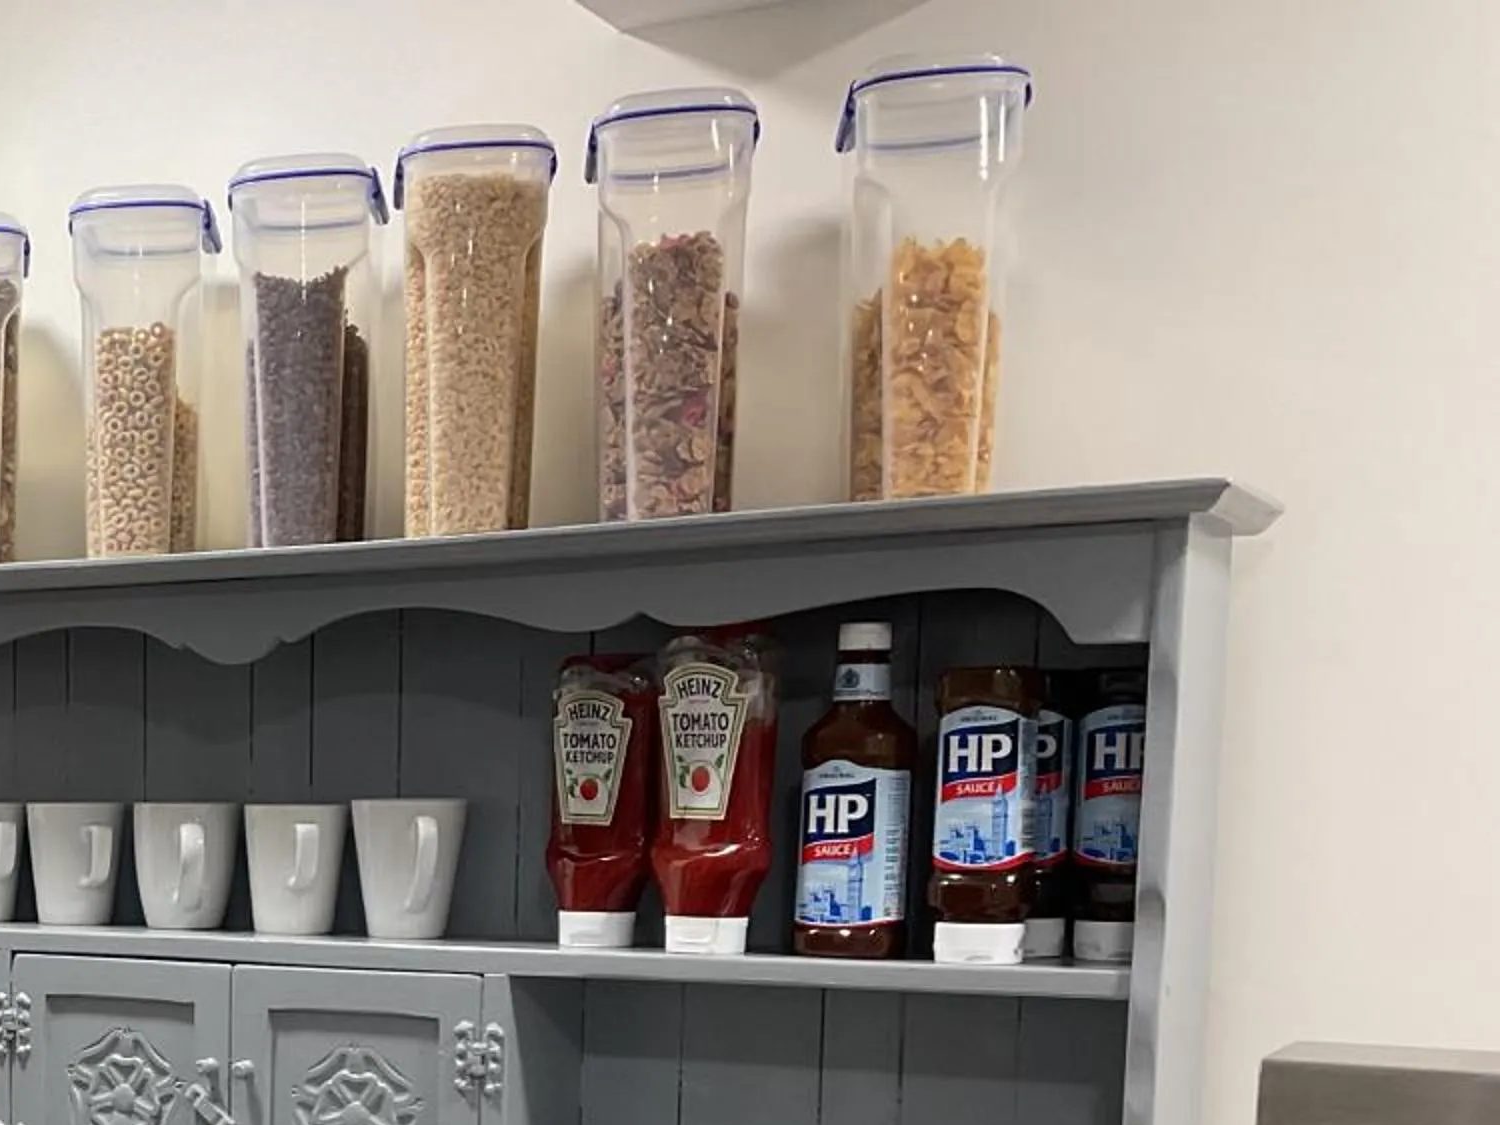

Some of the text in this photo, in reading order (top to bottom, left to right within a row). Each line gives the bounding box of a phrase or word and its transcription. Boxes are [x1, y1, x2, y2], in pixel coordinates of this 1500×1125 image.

[678, 678, 721, 699] HEINZ
[568, 704, 611, 720] HEINZ
[672, 713, 728, 731] TOMATO
[563, 733, 616, 749] TOMATO
[676, 733, 727, 749] KETCHUP
[566, 750, 614, 764] KETCHUP
[948, 734, 1013, 773] HP
[956, 783, 995, 795] SAUCE
[807, 794, 869, 834] HP
[814, 845, 852, 858] SAUCE
